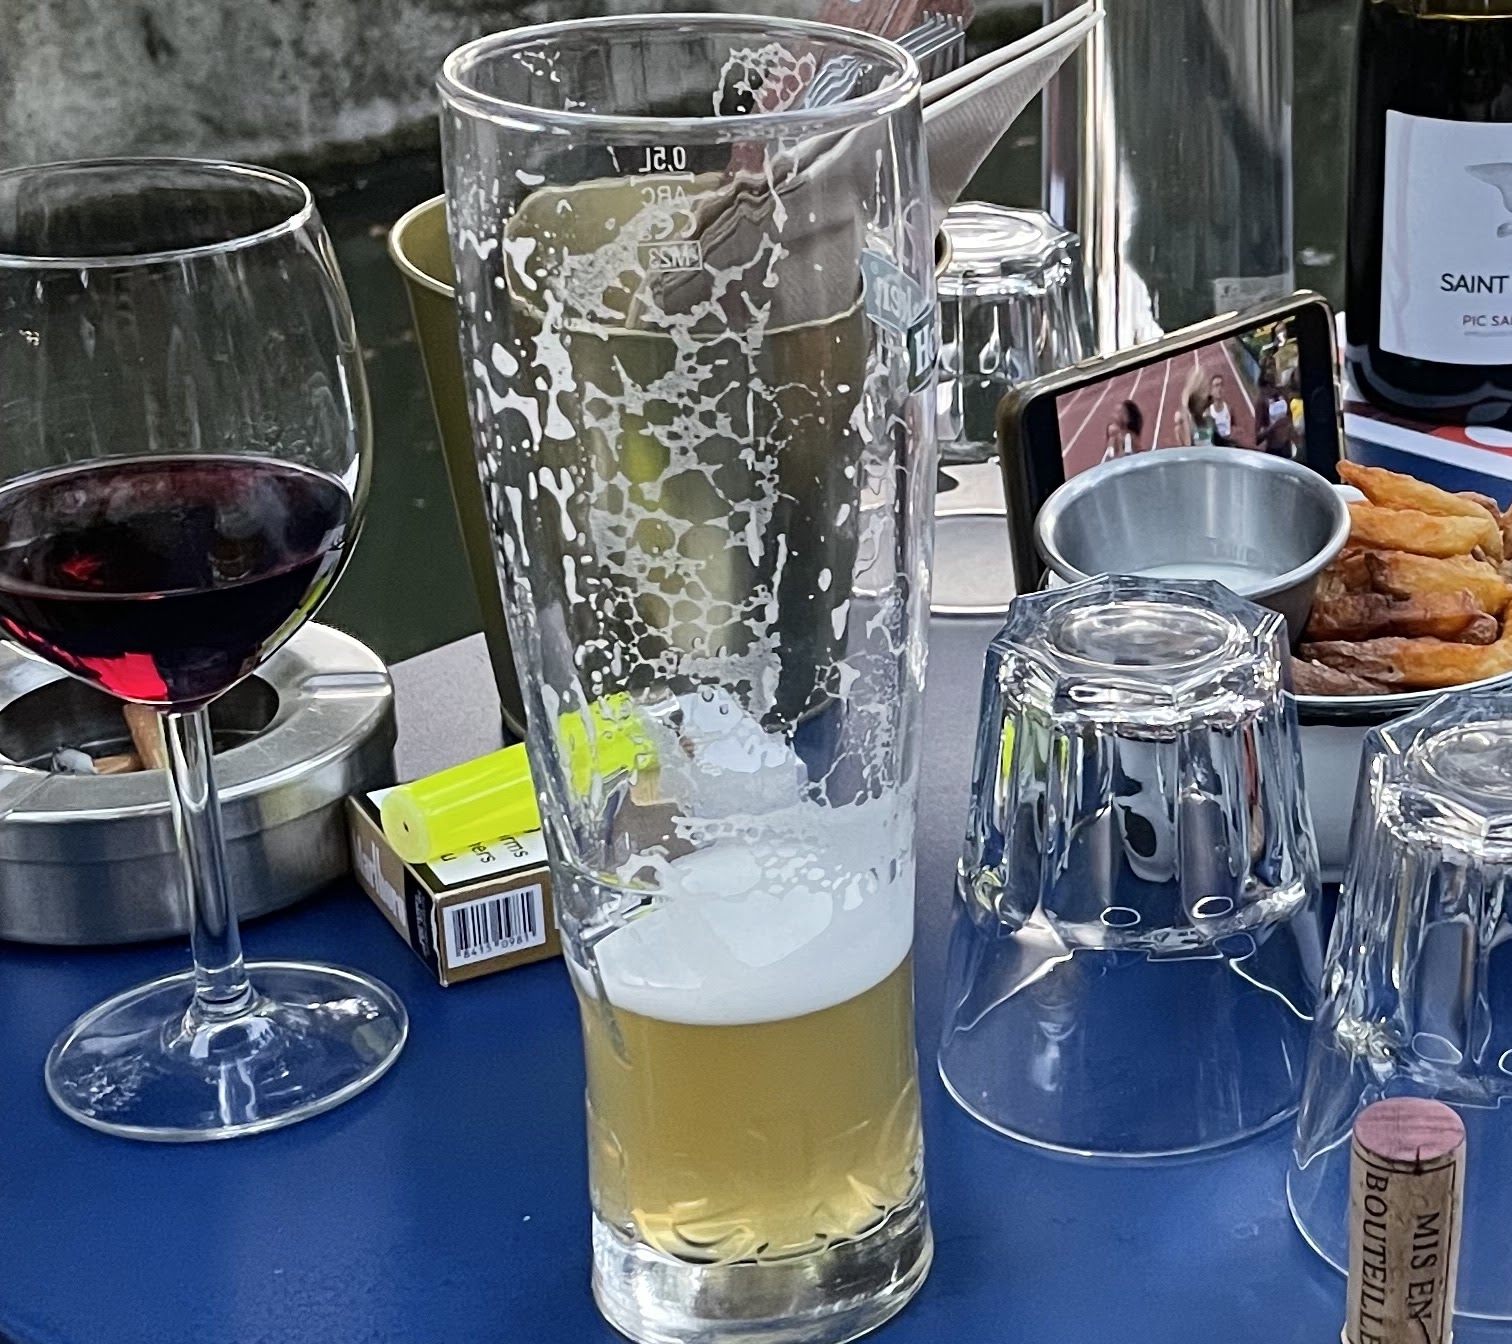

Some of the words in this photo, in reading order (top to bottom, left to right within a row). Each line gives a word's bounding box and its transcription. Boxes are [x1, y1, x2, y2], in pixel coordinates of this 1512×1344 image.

[1440, 272, 1510, 294] SAINT
[1462, 314, 1486, 326] PIC
[1410, 1211, 1440, 1270] MIS
